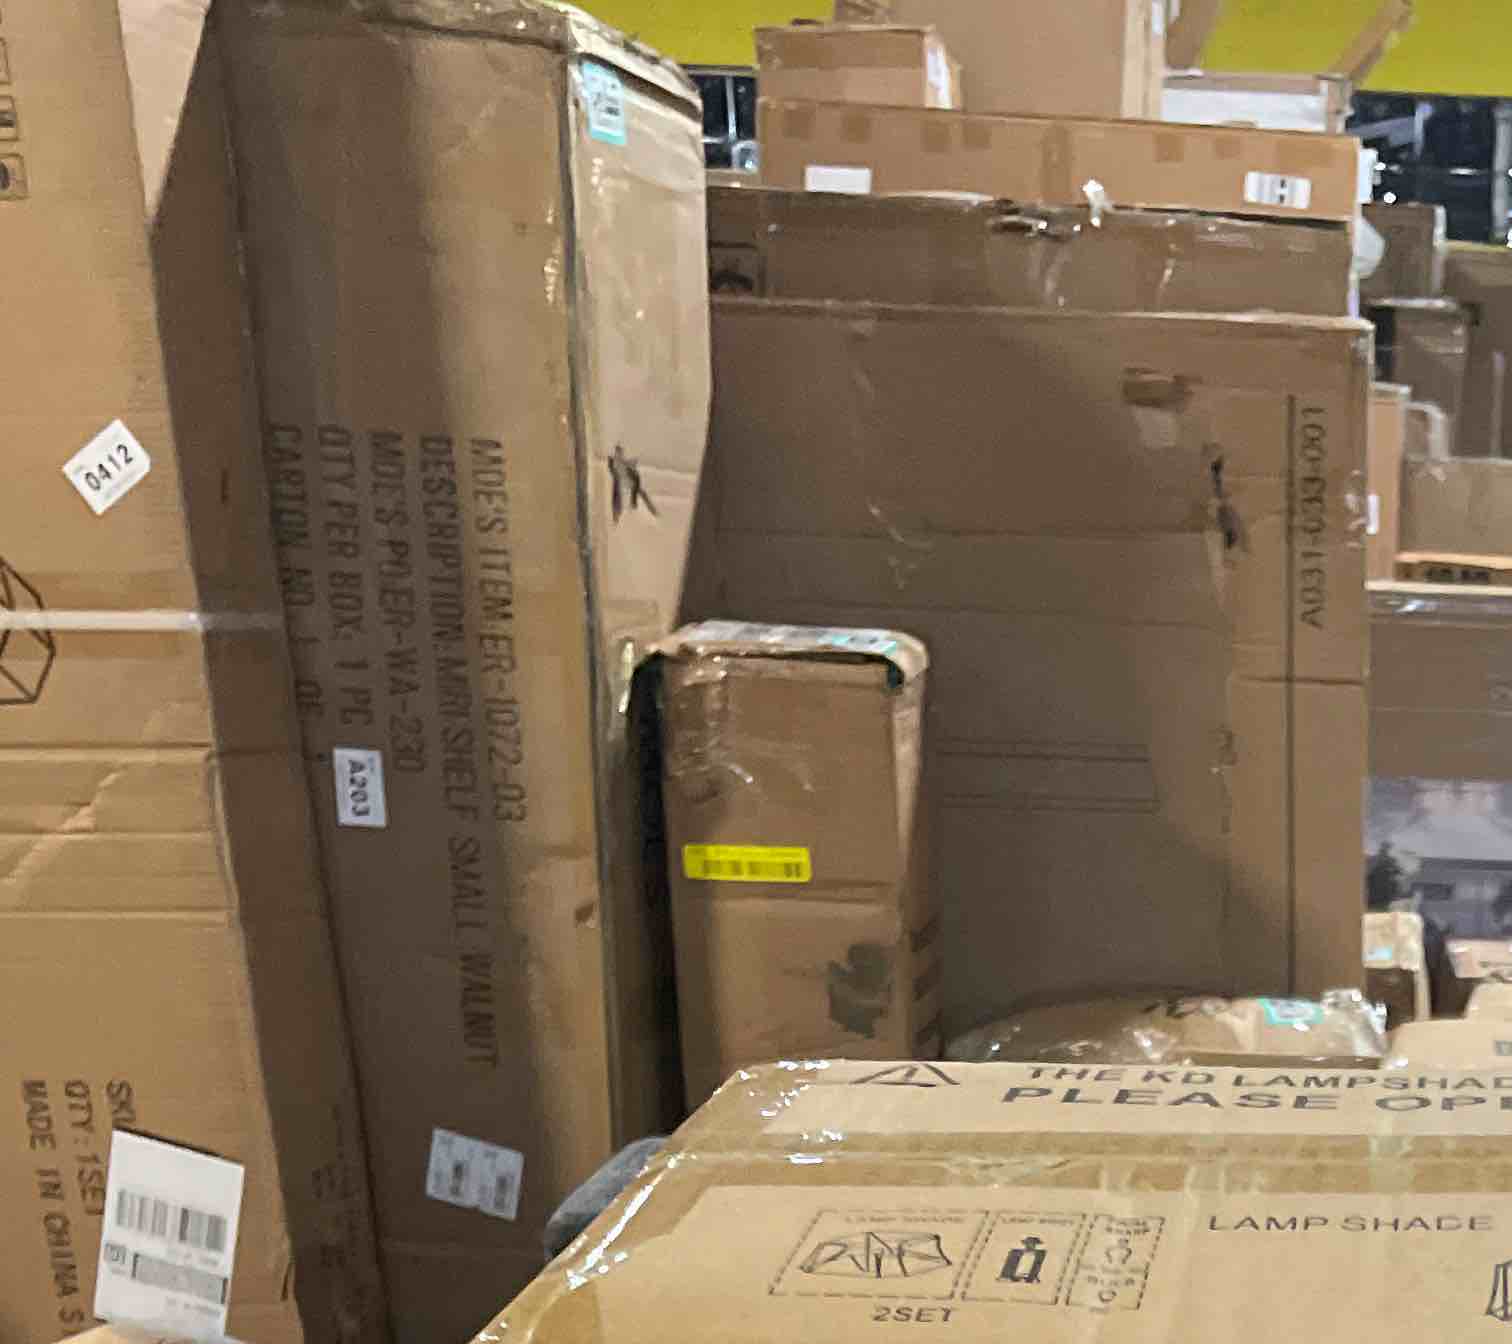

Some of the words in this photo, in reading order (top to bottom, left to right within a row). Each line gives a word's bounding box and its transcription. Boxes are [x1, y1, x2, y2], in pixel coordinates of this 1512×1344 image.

[83, 443, 135, 491] 0412
[1026, 1066, 1126, 1082] THE
[1142, 1069, 1215, 1085] KD
[1001, 1087, 1338, 1110] PLEASE
[22, 1079, 57, 1151] MADE
[36, 1167, 64, 1200] IN
[1207, 1215, 1329, 1232] LAMP
[1341, 1214, 1494, 1231] SHADE
[43, 1211, 79, 1298] CHINA
[871, 1306, 955, 1324] 2SET
